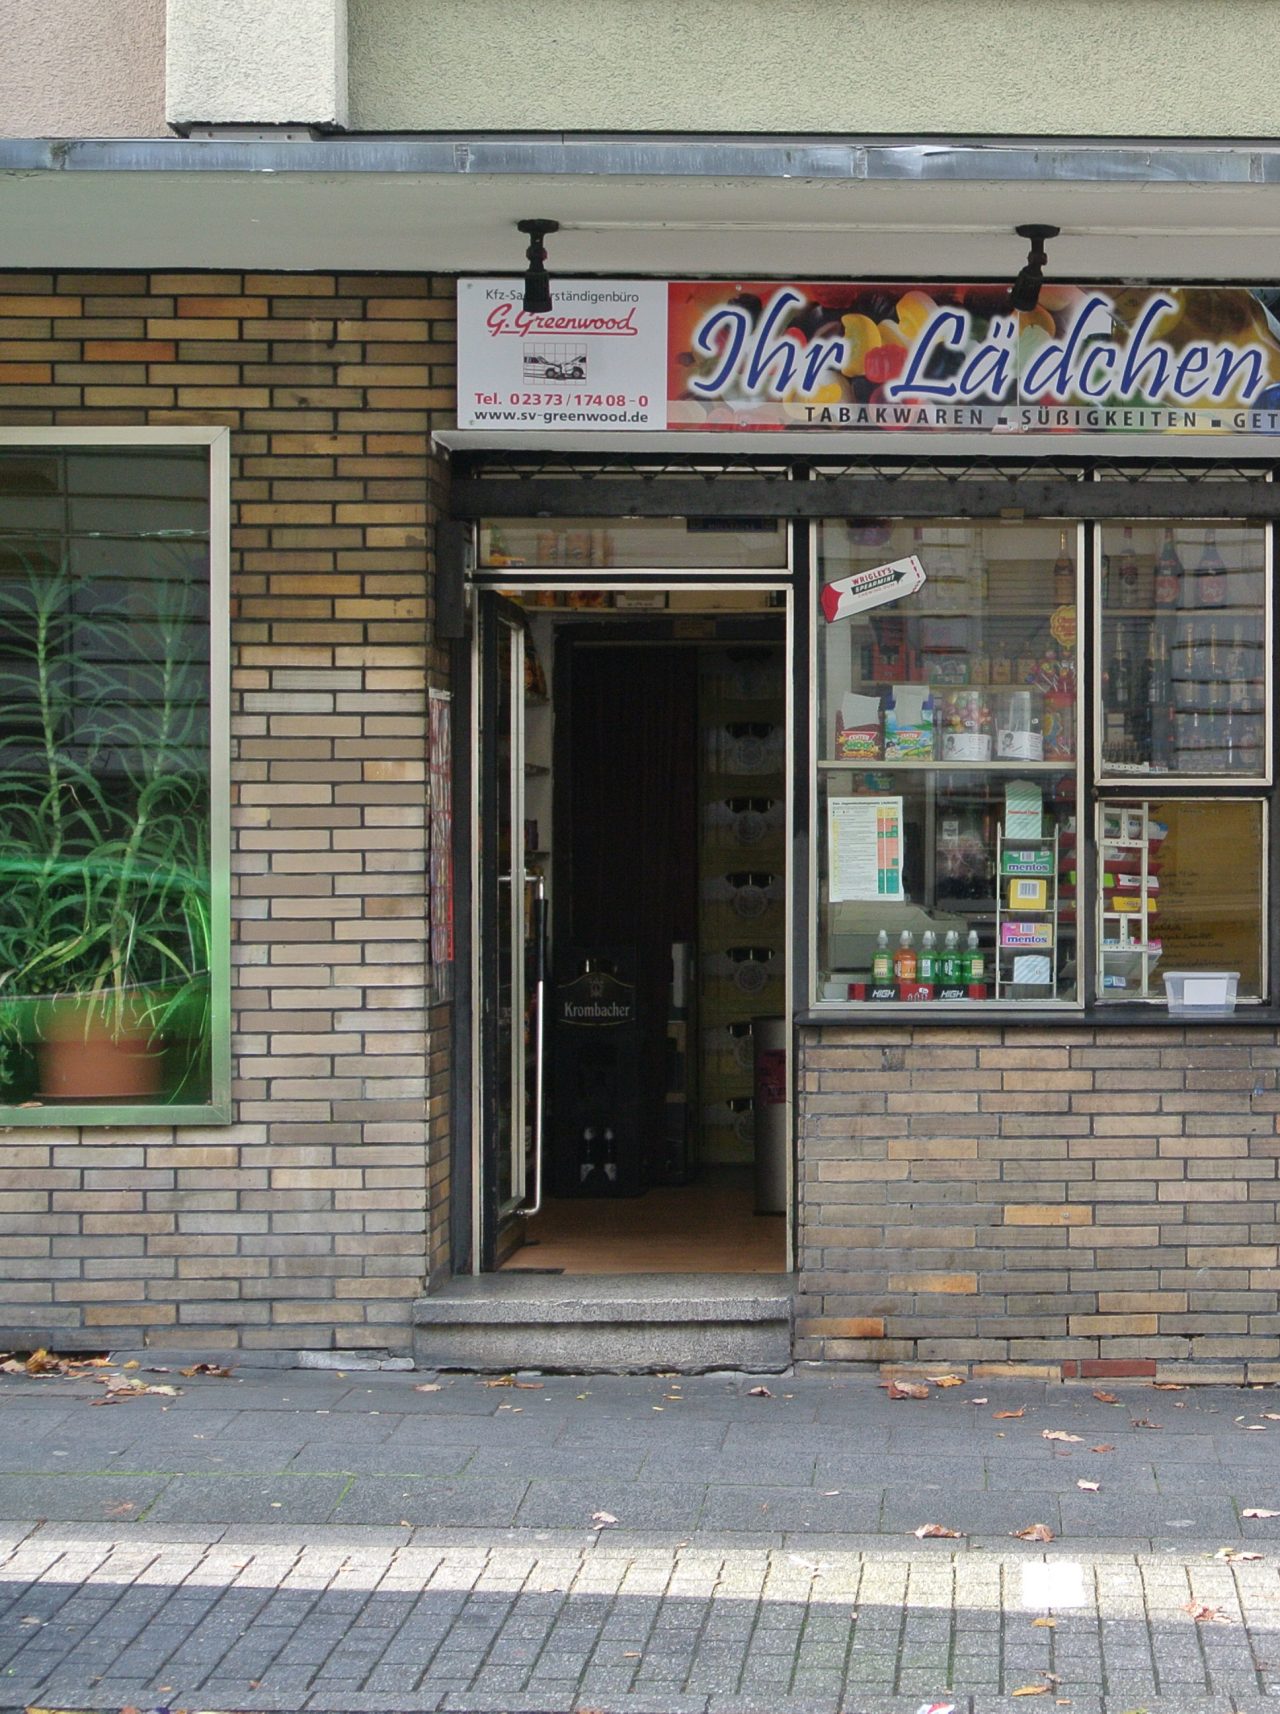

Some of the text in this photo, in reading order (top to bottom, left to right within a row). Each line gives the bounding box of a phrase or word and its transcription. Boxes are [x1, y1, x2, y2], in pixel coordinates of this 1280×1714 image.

[486, 289, 639, 304] Kfz-Sarständigenbüro
[514, 306, 639, 337] Greenwood
[694, 292, 844, 392] Ihr
[890, 297, 1266, 400] Lädchen
[474, 392, 502, 405] Tel.
[474, 410, 649, 425] www.sv-greenwood.de
[805, 406, 984, 426] TABAKWAREN
[851, 567, 893, 585] WRIGLEY'S
[854, 573, 896, 593] SPEARMINT
[1007, 864, 1049, 872] mentos
[1007, 935, 1048, 943] mentos
[872, 989, 896, 998] HIGH
[940, 990, 964, 998] HIGH
[564, 1001, 631, 1017] Krombacher
